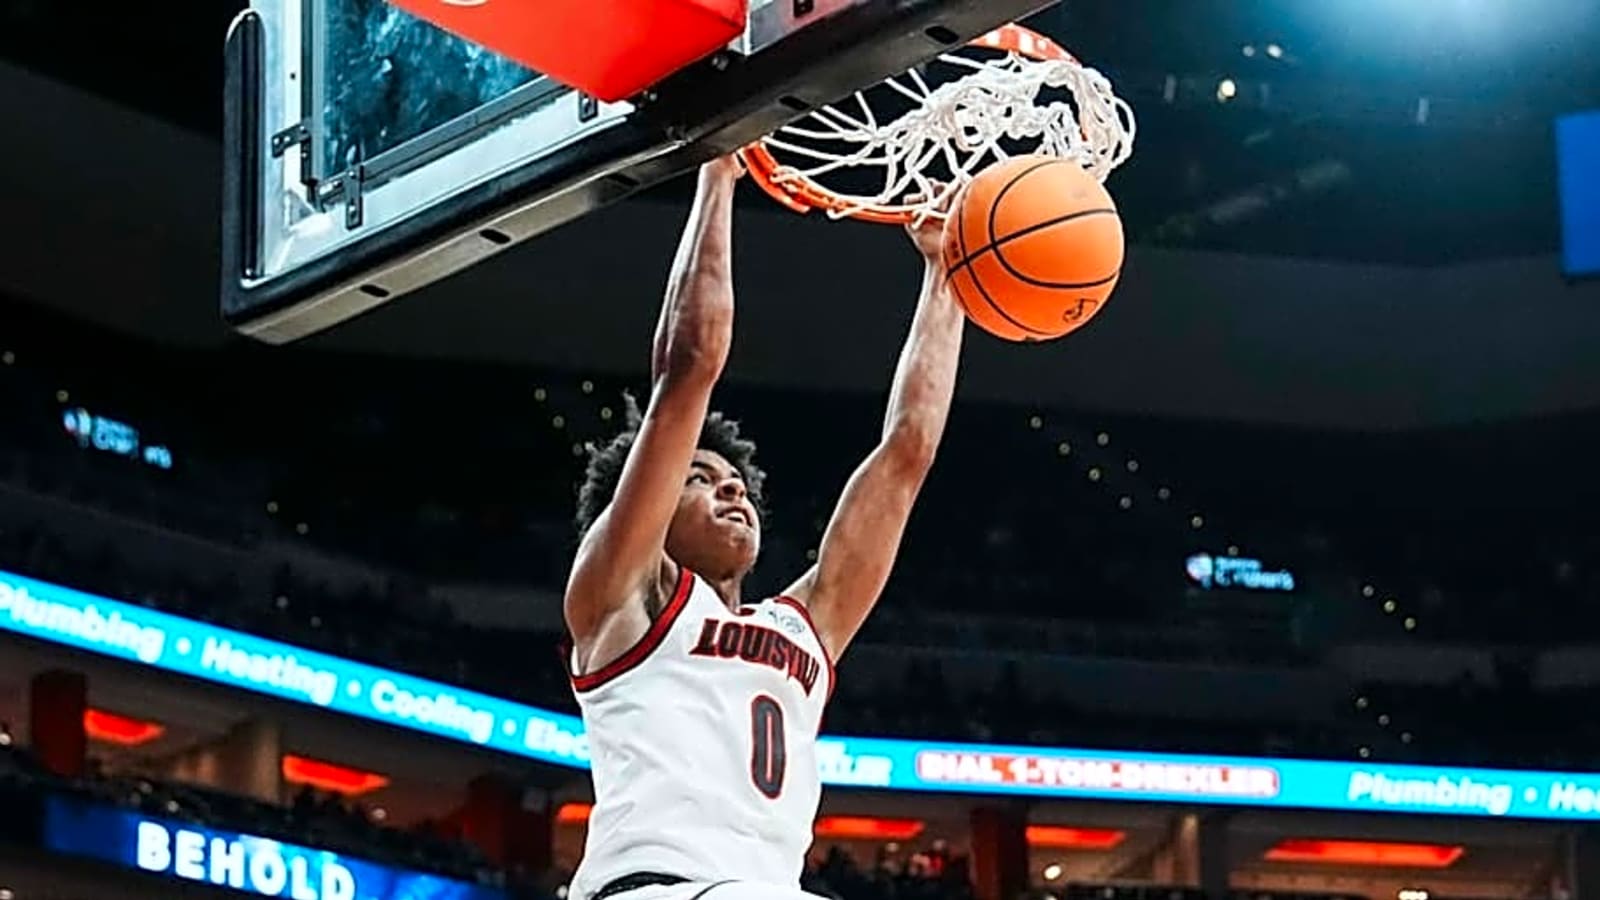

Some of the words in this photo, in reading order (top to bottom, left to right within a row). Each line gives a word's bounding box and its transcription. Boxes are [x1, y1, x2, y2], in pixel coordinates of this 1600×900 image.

[201, 636, 338, 706] Heating
[370, 679, 494, 744] Cooling
[751, 695, 785, 799] 0
[920, 752, 1003, 783] DIAL
[1348, 770, 1512, 815] Plumbing
[137, 821, 355, 900] BEHOLD
